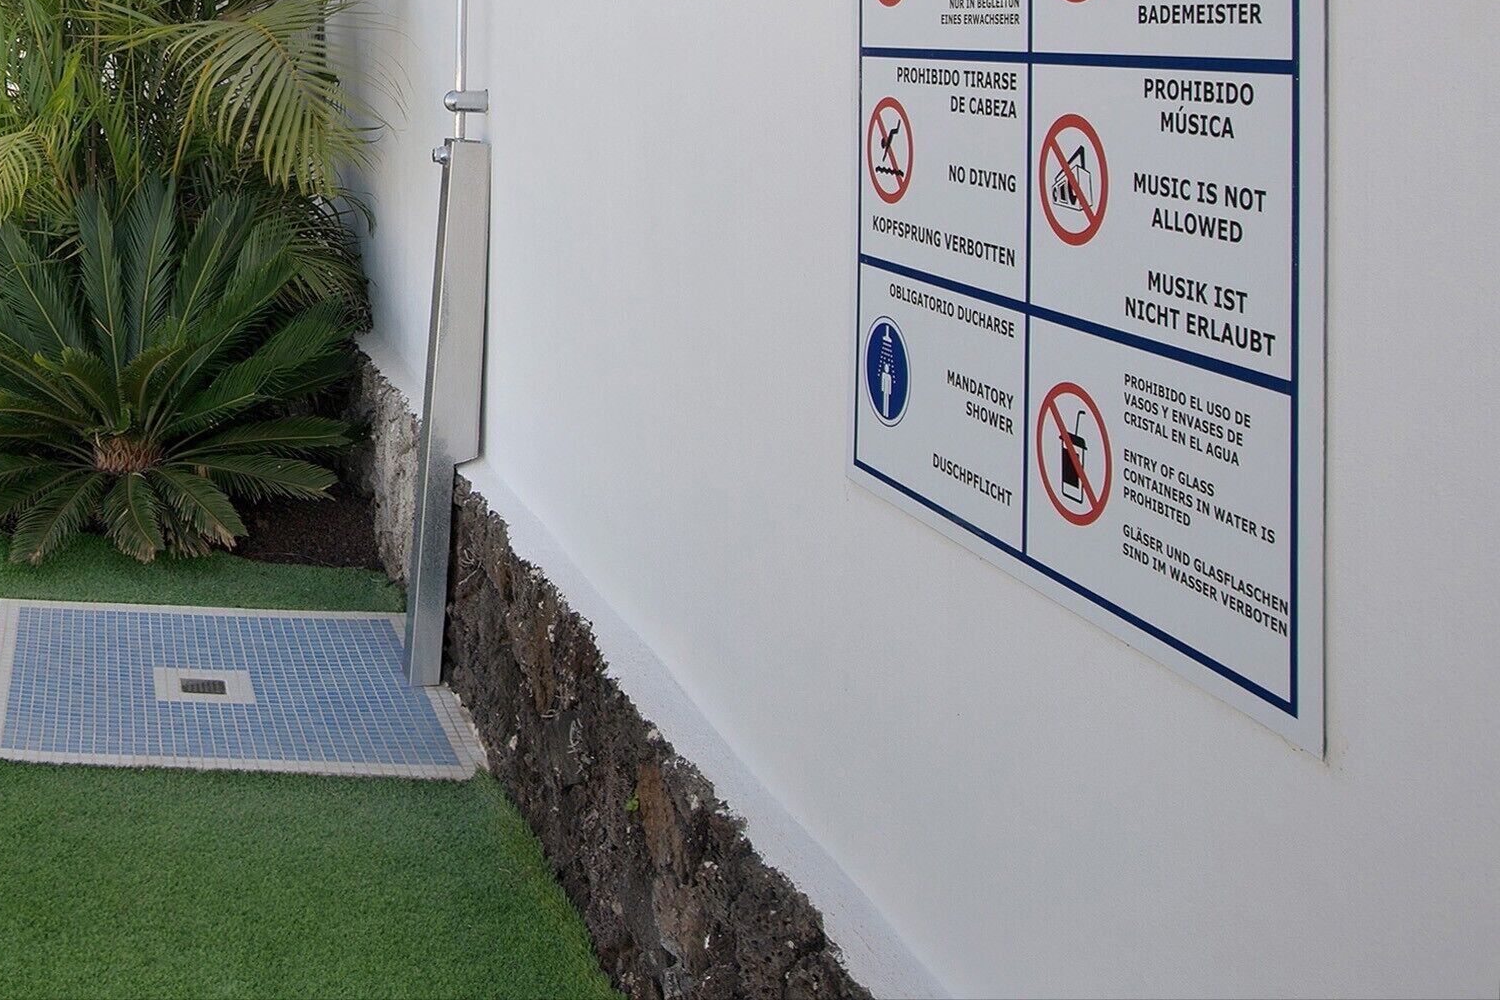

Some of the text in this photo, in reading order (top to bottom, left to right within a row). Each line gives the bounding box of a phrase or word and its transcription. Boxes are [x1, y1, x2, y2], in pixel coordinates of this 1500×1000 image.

[940, 14, 962, 25] EINES
[1138, 3, 1262, 24] BADEMEISTER
[897, 66, 1017, 91] PROHIBIDO TIRARSE
[1144, 78, 1254, 106] PROHIBIDO
[950, 95, 1017, 118] DE CABEZA
[1161, 105, 1234, 139] MÚSICA
[948, 164, 1016, 193] NO DIVING
[1133, 172, 1267, 212] MUSIC IS NOT
[872, 215, 1015, 267] KOPFSPRUNG VERBOTTEN
[1151, 207, 1243, 243] ALLOWED
[889, 283, 1014, 338] OBLIGATORIO DUCHARSE
[1148, 270, 1248, 314] MUSIK IST
[1125, 296, 1276, 356] NICHT ERLAUBT
[947, 369, 1014, 410] MANDATORY
[1124, 373, 1251, 428] PROHIBIDO EL USO DE
[965, 400, 1013, 435] SHOWER
[1123, 391, 1243, 447] VASOS Y ENVASES DE
[1123, 411, 1240, 466] CRISTAL EN EL AGUA
[932, 452, 1012, 506] DUSCHPFLICHT
[1124, 448, 1214, 497] ENTRY OF GLASS
[1123, 467, 1275, 544] CONTAINERS IN WATER IS
[1123, 485, 1191, 526] PROHIBITED
[1122, 524, 1288, 616] GLÄSER UND GLASFLASCHEN
[1122, 542, 1287, 637] SIND IM WASSER VERBOTEN
